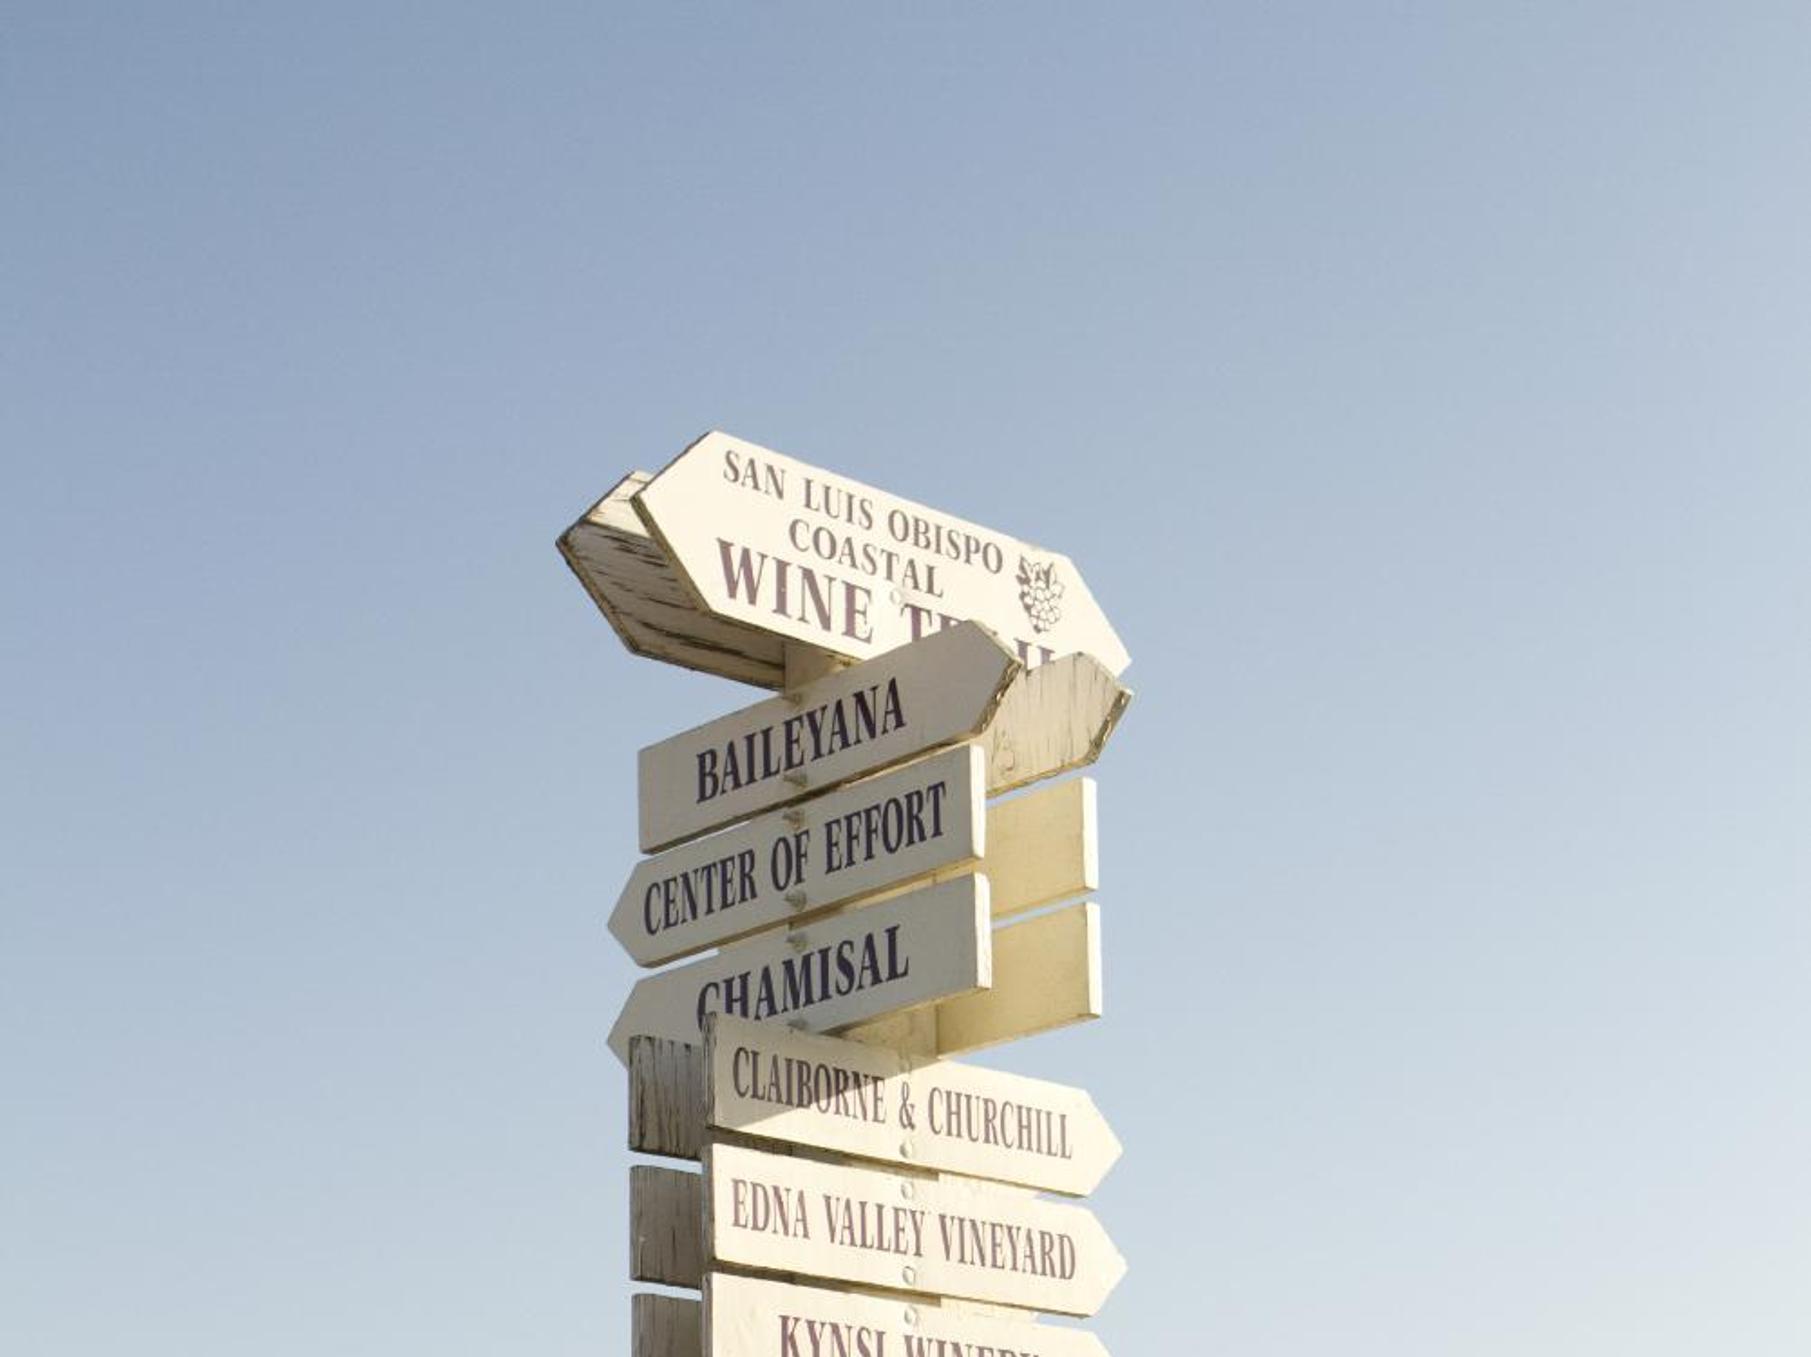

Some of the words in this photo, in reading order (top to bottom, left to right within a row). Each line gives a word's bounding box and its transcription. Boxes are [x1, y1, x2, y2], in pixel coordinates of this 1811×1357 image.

[723, 450, 786, 501] SAN
[803, 477, 873, 531] LUIS
[888, 509, 1003, 575] OBISPO
[788, 518, 944, 598] COASTAL
[715, 537, 873, 645] WINE
[696, 676, 907, 804] BAILEYANA
[644, 849, 758, 936] CENTER
[771, 829, 811, 892] OF
[824, 781, 946, 875] EFFORT
[732, 1046, 887, 1125] CLAIBORNE
[899, 1080, 916, 1130] &
[927, 1086, 1073, 1160] CHURCHILL
[730, 1178, 811, 1240] EDNA
[822, 1194, 925, 1258] VALLEY
[938, 1213, 1077, 1281] VINEYARD
